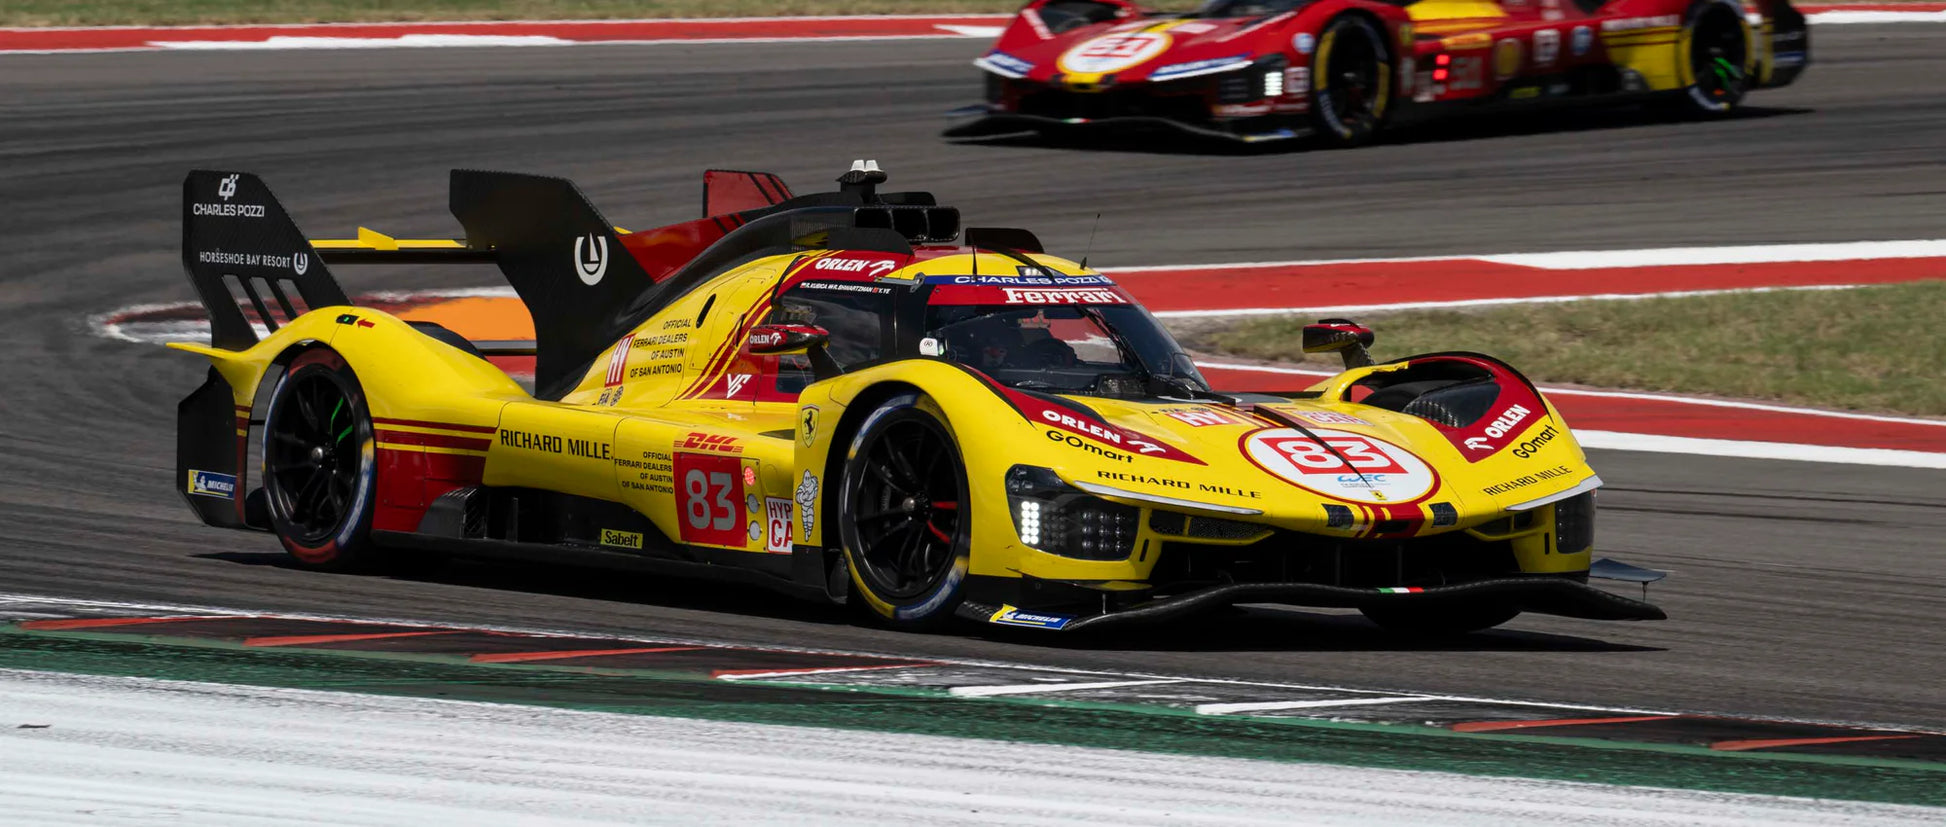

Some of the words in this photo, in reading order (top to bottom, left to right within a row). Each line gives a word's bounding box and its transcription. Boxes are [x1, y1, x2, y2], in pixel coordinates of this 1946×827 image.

[193, 203, 236, 216] CHARLES
[237, 204, 265, 217] POZZI
[199, 251, 244, 265] HORSESHOE
[246, 254, 261, 265] BAY
[262, 255, 291, 268] RESORT
[815, 257, 870, 272] ORLEN
[954, 275, 1053, 284] CHARLES
[1054, 276, 1097, 285] POZZI
[1002, 287, 1128, 304] Ferrari
[663, 319, 692, 330] OFFICIAL
[632, 337, 657, 349] FERRARI
[657, 333, 688, 345] DEALERS
[749, 334, 770, 345] ORLEN
[650, 351, 660, 360] OF
[660, 348, 685, 359] AUSTIN
[629, 367, 639, 378] OF
[638, 366, 652, 377] SAN
[652, 363, 683, 375] ANTONIO
[1042, 409, 1121, 444] ORLEN
[1484, 403, 1531, 439] ORLEN
[500, 428, 562, 454] RICHARD
[683, 432, 739, 452] DHL
[1046, 429, 1135, 463] GOmart
[1512, 424, 1559, 459] GOmart
[642, 451, 672, 462] OFFICIAL
[1276, 440, 1393, 469] 83
[614, 458, 642, 469] FERRARI
[643, 463, 672, 473] DEALERS
[639, 472, 648, 481] OF
[649, 473, 673, 484] AUSTIN
[1097, 470, 1191, 490] RICHARD
[1199, 483, 1263, 500] MILLE
[1337, 474, 1387, 483] WEC
[1483, 475, 1538, 496] RICHARD
[1534, 465, 1573, 482] MILLE
[621, 480, 630, 489] OF
[631, 481, 645, 491] SAN
[645, 483, 674, 495] ANTONIO
[685, 468, 736, 532] 83
[605, 530, 639, 548] Sabelt
